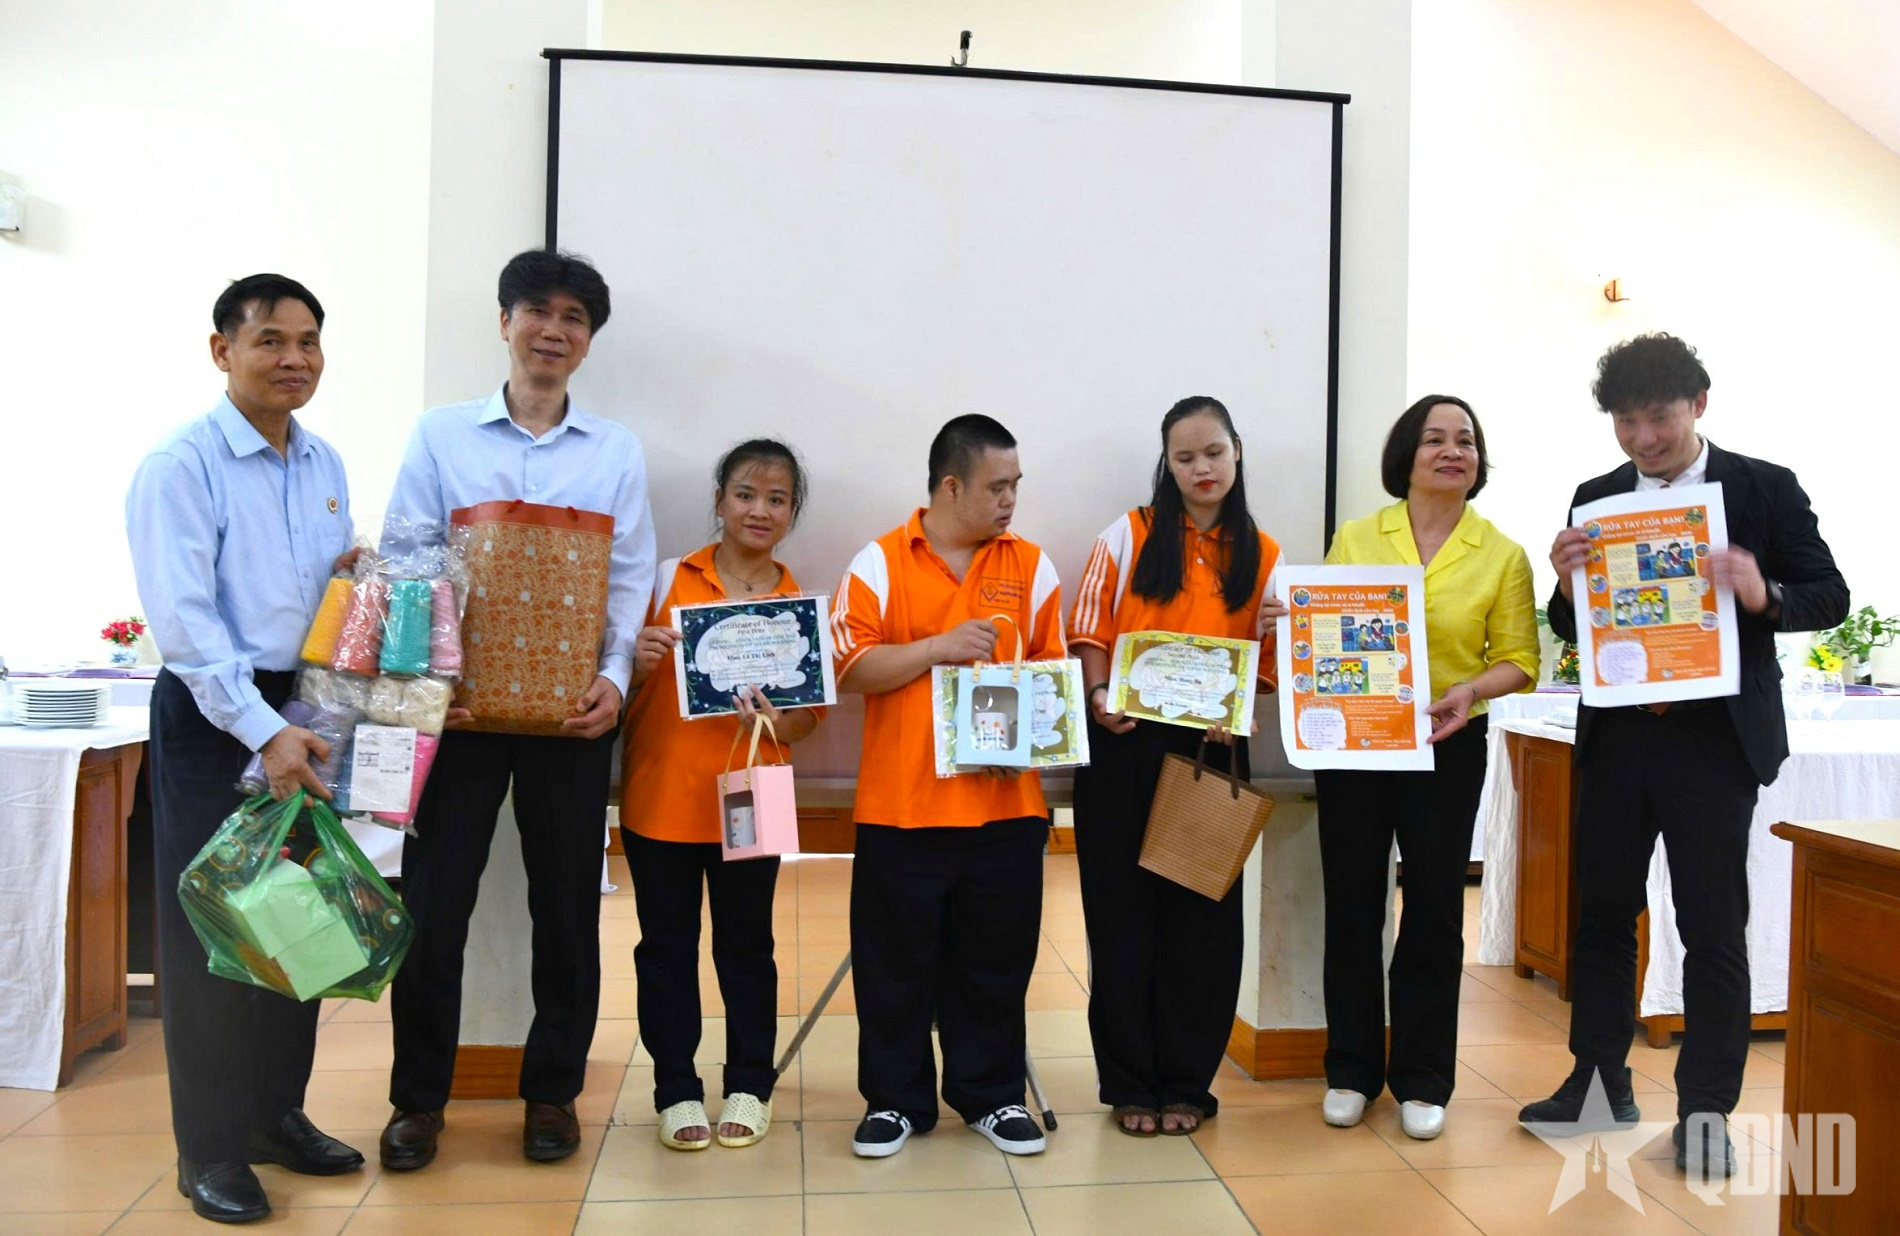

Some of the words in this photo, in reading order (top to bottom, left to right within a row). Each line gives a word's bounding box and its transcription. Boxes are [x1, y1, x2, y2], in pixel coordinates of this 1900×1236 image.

[1624, 519, 1641, 529] TAY
[1349, 591, 1366, 600] CỦA
[714, 621, 753, 631] Certificate
[753, 619, 761, 628] of
[763, 618, 791, 627] Honour
